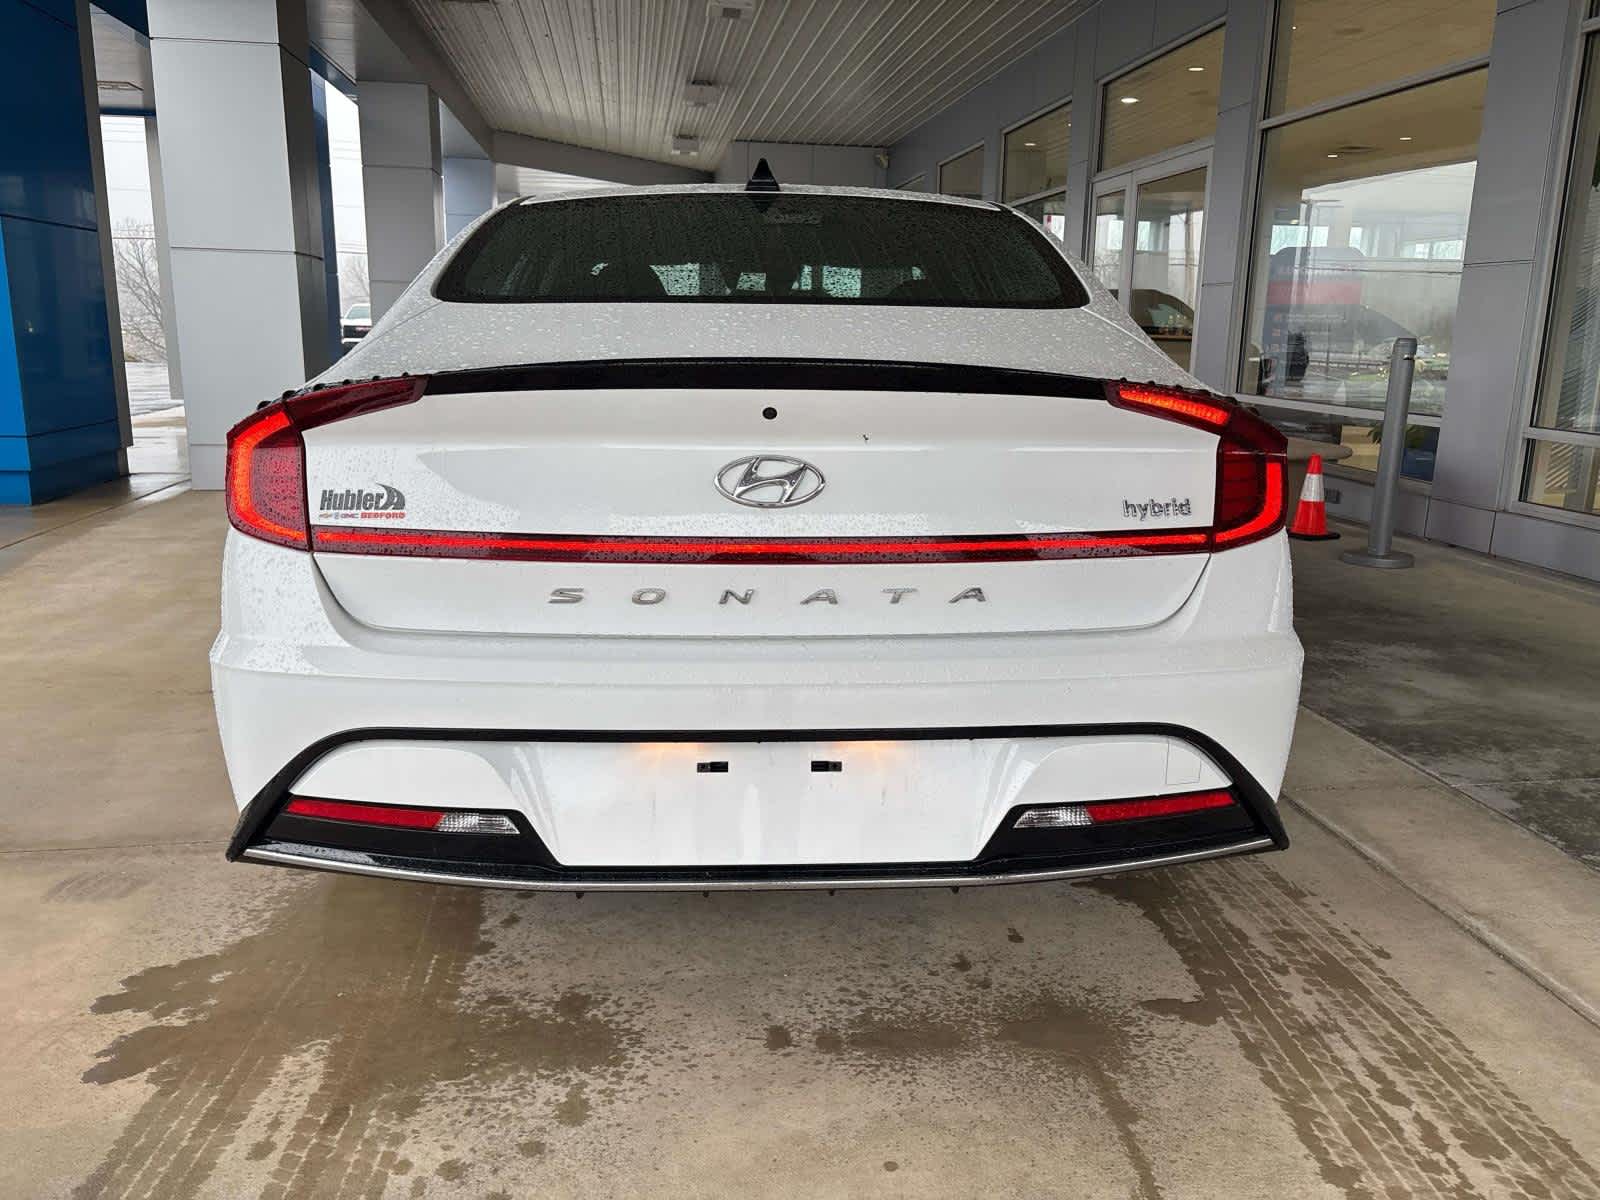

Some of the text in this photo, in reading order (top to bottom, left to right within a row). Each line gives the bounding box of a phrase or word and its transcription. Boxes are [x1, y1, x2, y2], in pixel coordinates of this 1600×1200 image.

[320, 489, 385, 511] Hubler
[1122, 497, 1192, 521] hybrid
[360, 511, 406, 520] BEDFORD
[548, 587, 988, 605] SONATA
